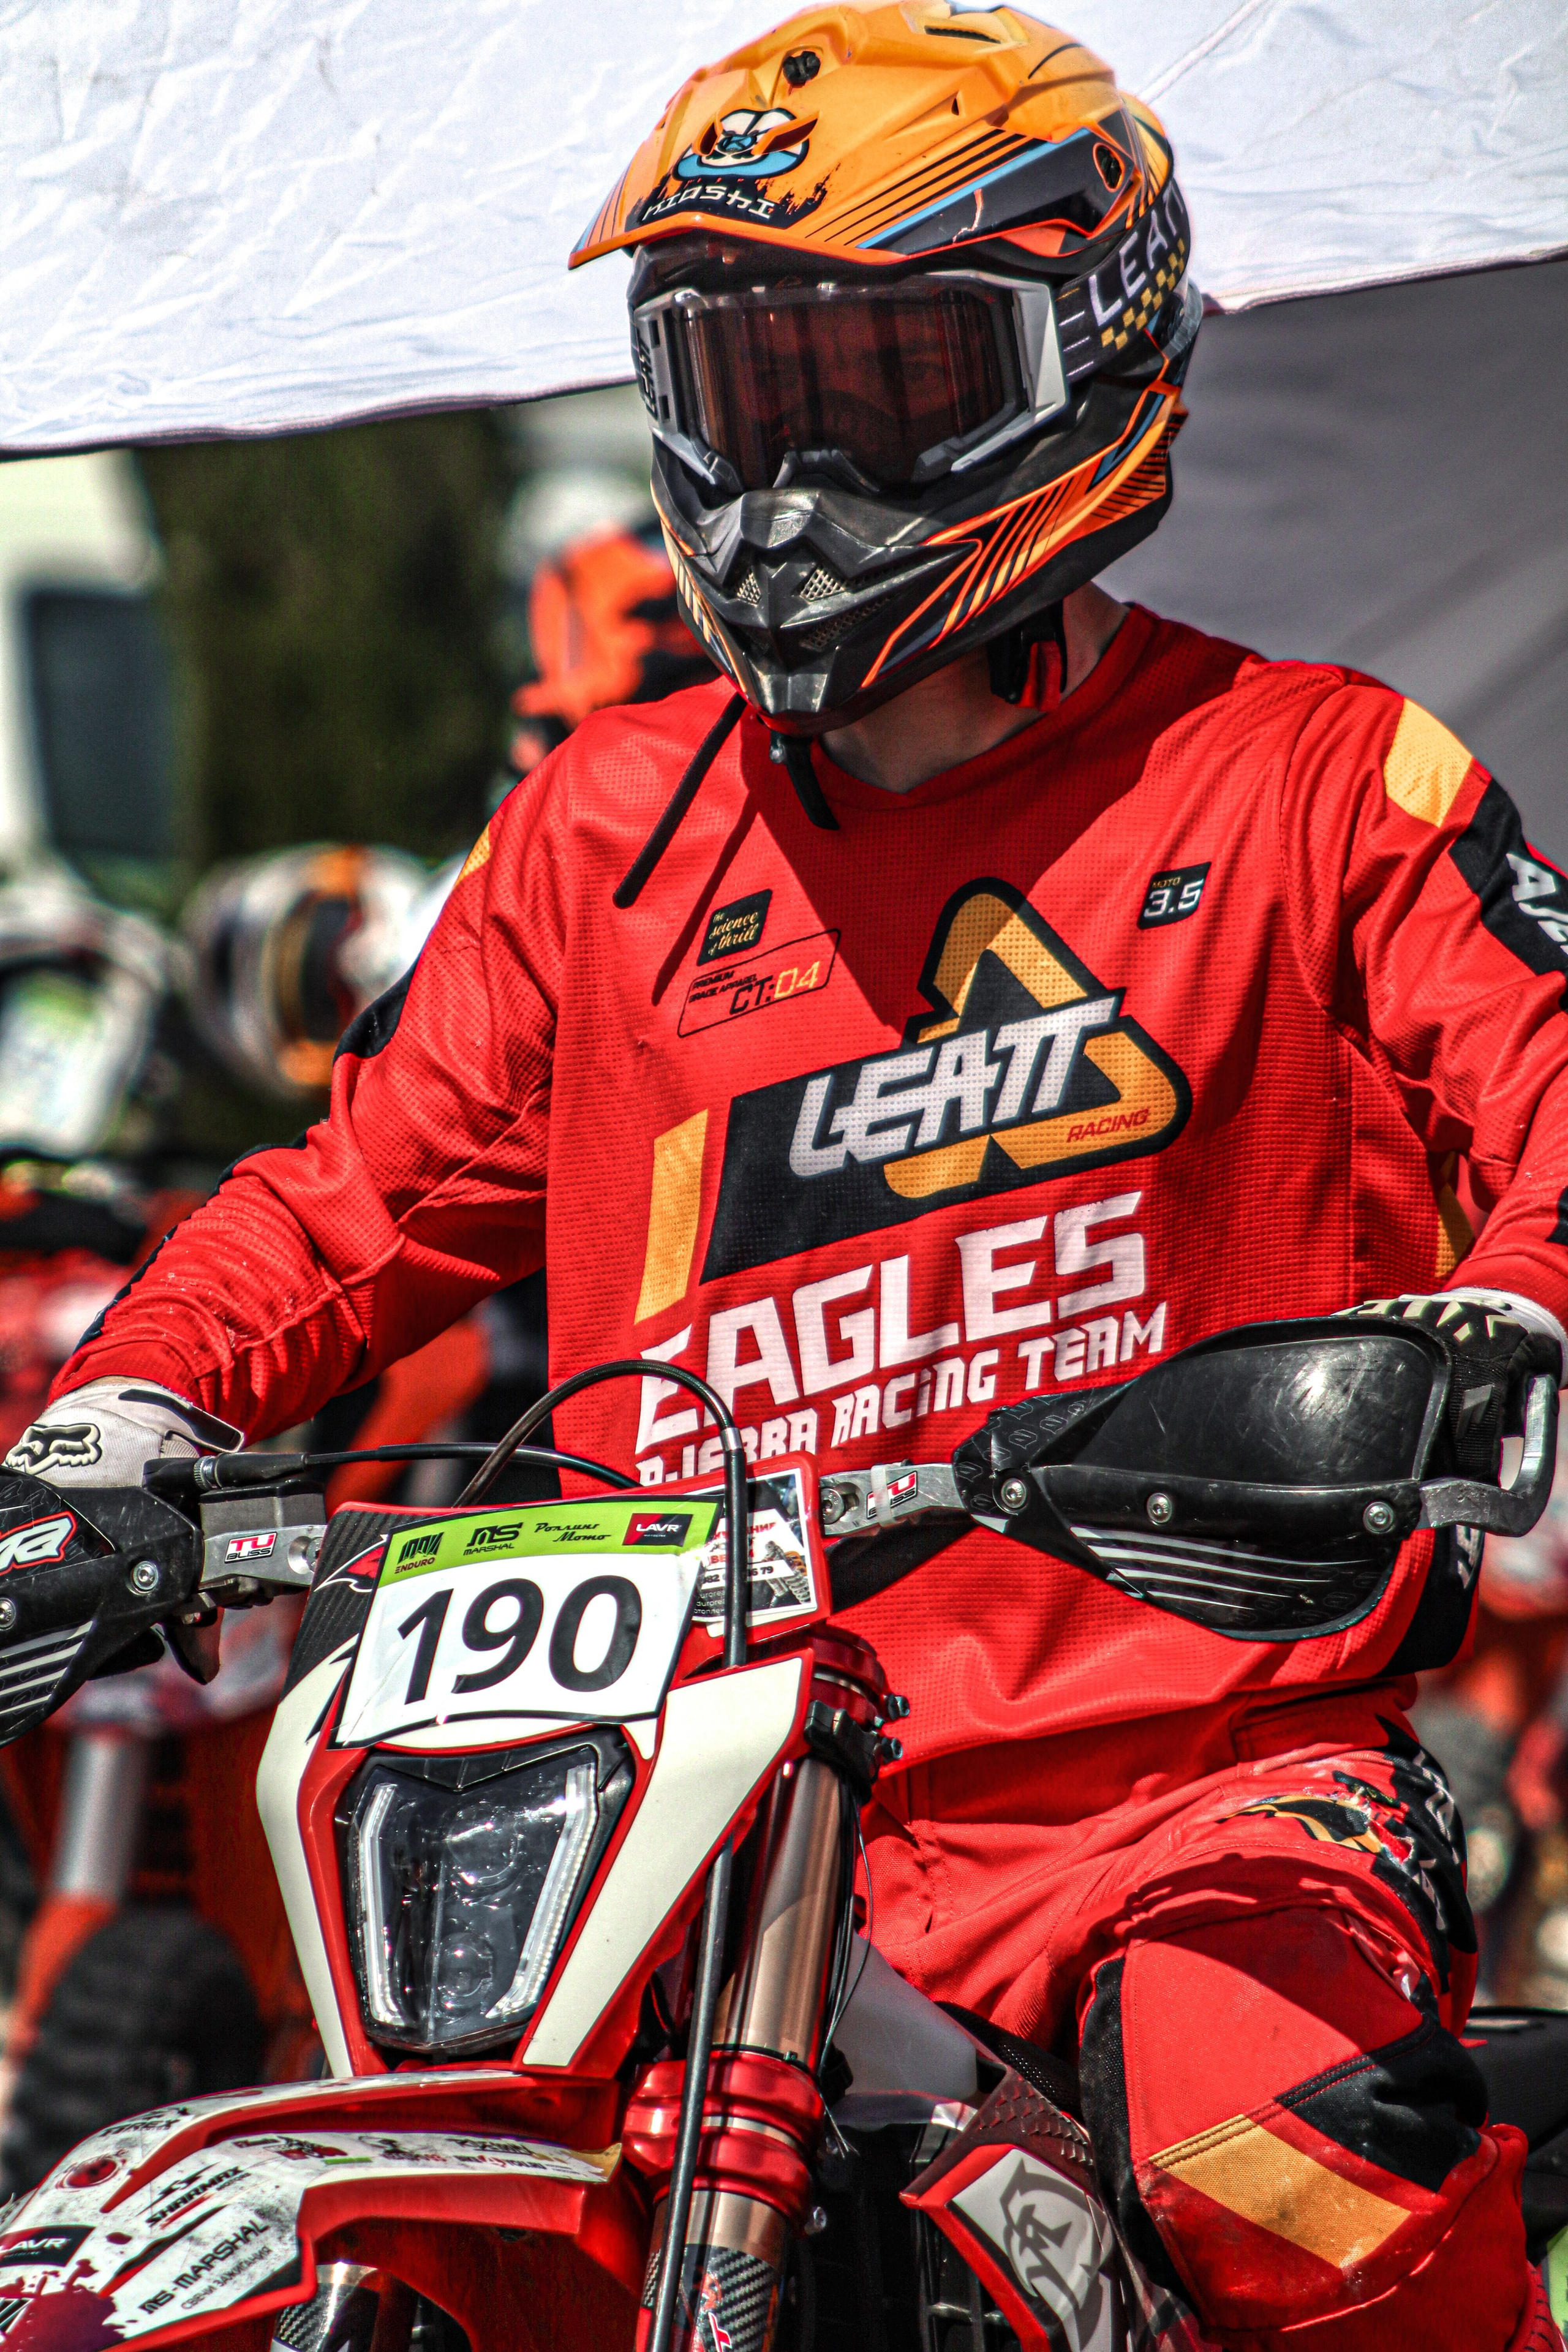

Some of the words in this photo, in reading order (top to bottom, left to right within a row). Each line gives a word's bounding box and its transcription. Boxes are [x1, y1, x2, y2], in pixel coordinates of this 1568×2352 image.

[1144, 878, 1204, 918] 3.5
[1152, 876, 1181, 889] MOTO
[709, 912, 758, 940] science
[718, 923, 759, 949] thrill
[789, 997, 1117, 1177] LEATT
[1066, 1108, 1150, 1143] RACING
[635, 1191, 1145, 1455] EAGLES
[1017, 1302, 1166, 1391] TEAM
[636, 1523, 679, 1532] LAVR
[227, 1547, 271, 1561] BLISS
[394, 1556, 435, 1574] ENDURO
[463, 1543, 514, 1556] MARSHAL
[397, 1575, 643, 1705] 190
[145, 2165, 246, 2228] SHARMAX
